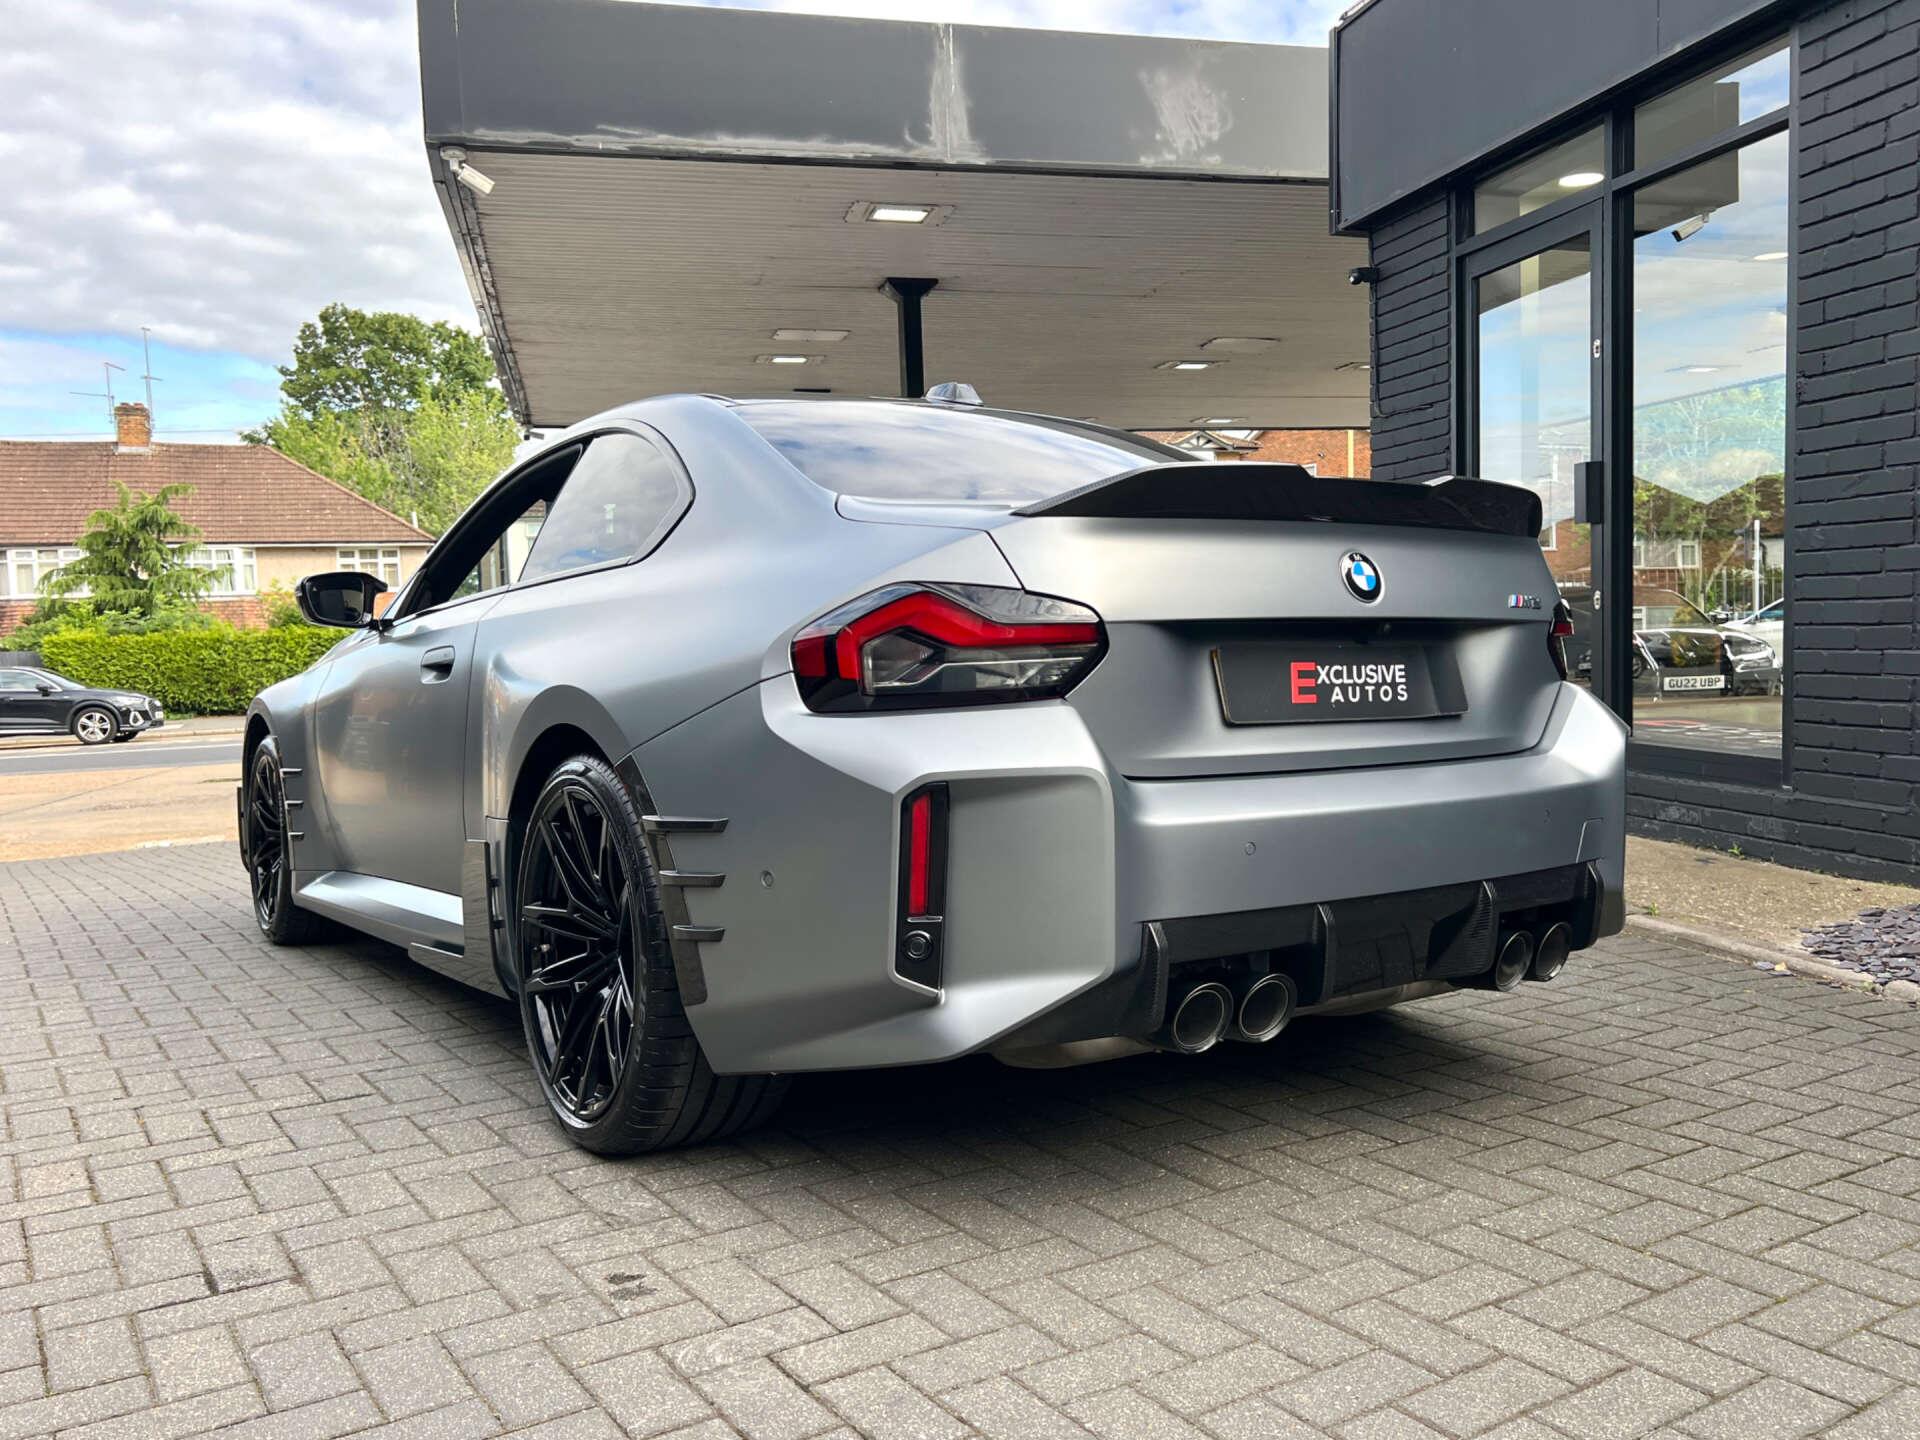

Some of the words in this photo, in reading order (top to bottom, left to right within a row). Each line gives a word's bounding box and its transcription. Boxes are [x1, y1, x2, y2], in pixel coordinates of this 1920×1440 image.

[1291, 662, 1406, 704] EXCLUSIVE
[1668, 678, 1697, 689] GU22
[1700, 677, 1721, 688] UBP
[1331, 685, 1408, 703] AUTOS
